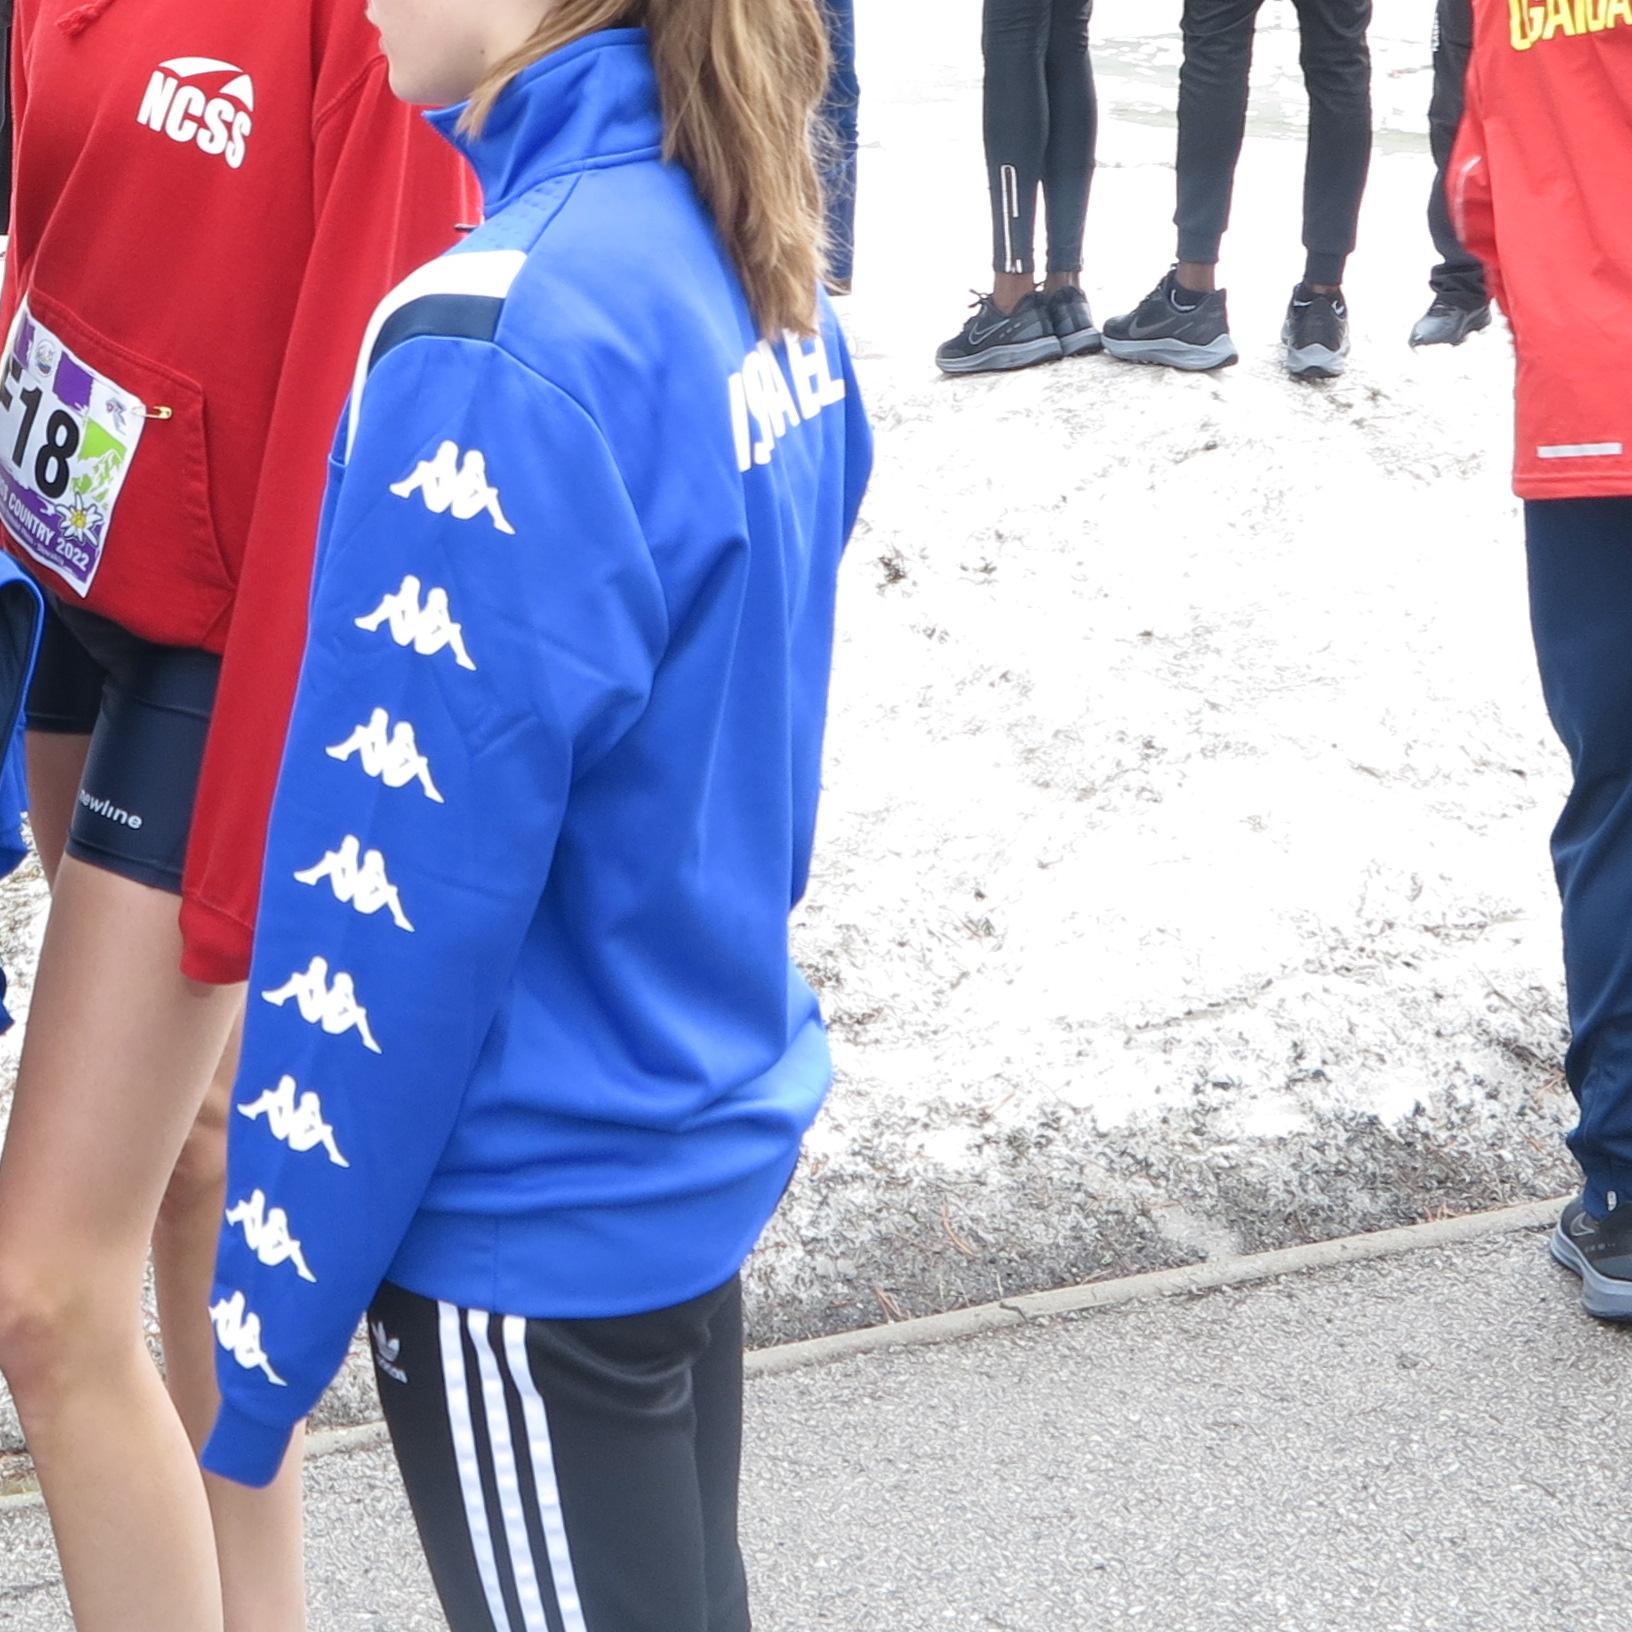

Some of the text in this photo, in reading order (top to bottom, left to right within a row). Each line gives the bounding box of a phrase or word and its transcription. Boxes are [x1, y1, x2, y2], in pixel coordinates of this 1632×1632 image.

[136, 69, 252, 169] NCSS
[8, 492, 56, 546] COUNTRY
[55, 538, 90, 572] 2022
